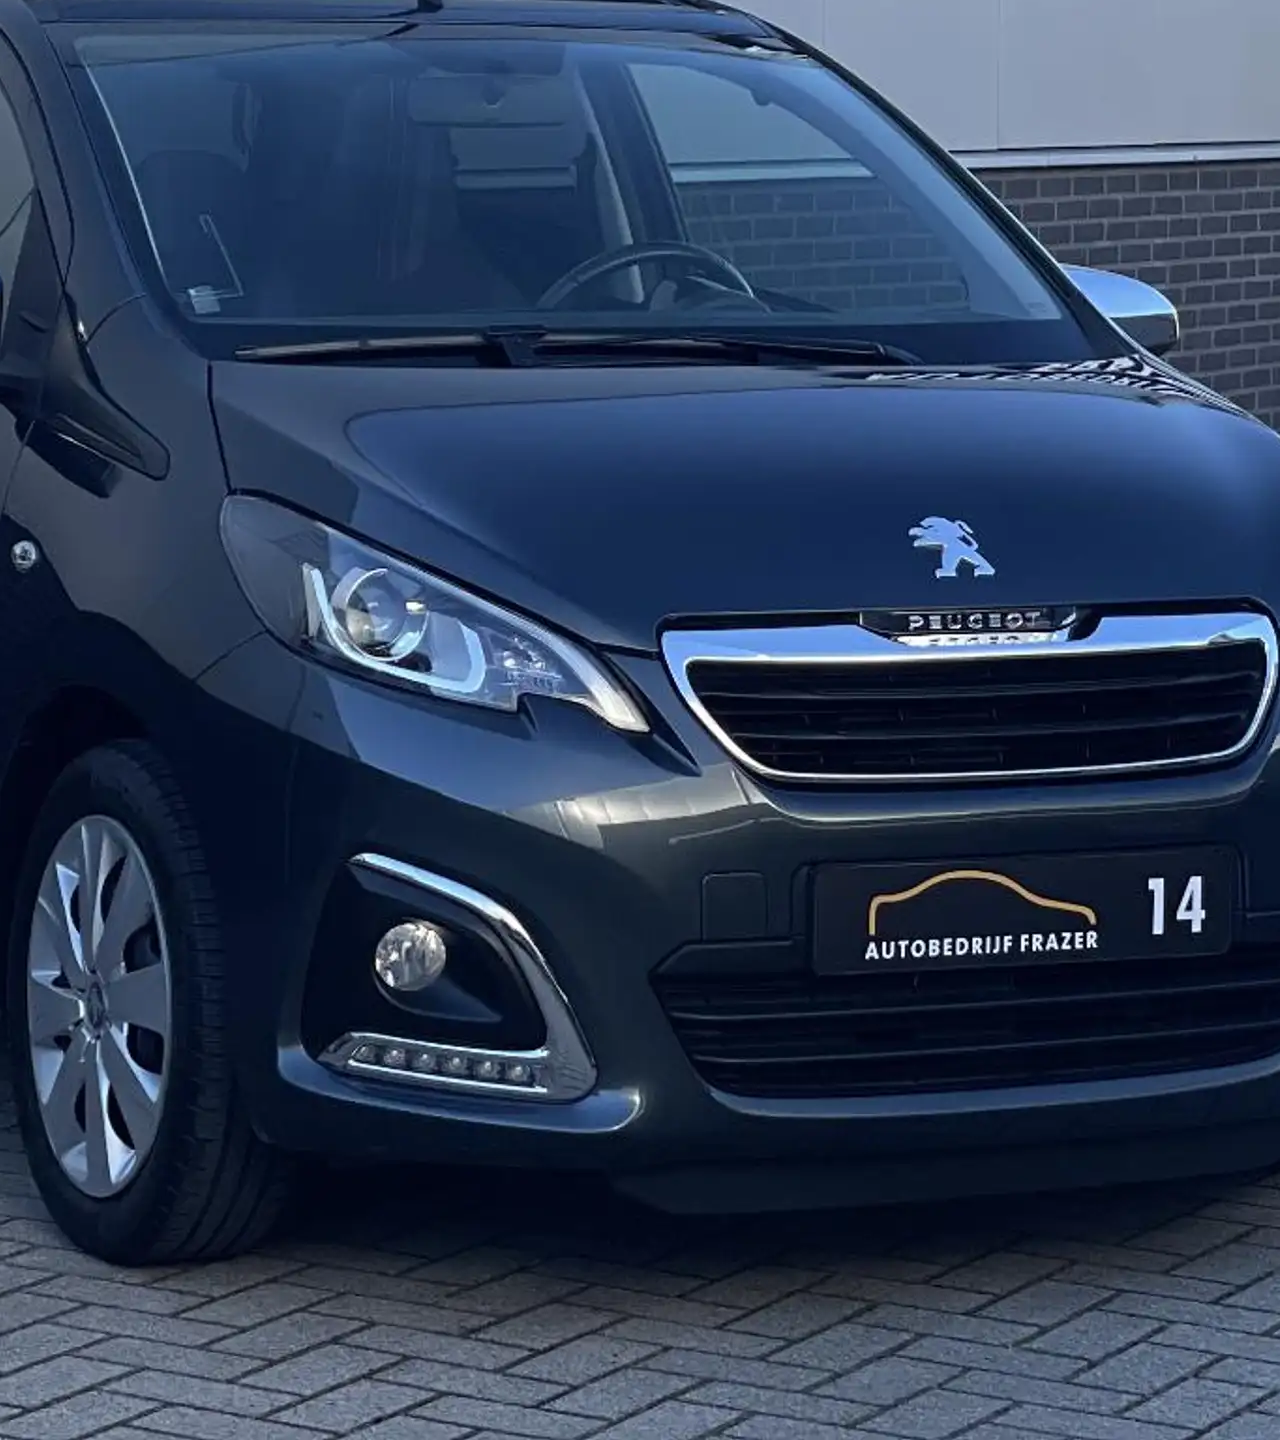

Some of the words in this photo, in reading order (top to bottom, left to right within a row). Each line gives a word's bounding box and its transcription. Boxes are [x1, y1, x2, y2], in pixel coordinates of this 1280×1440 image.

[907, 610, 1041, 632] PEUGEOT
[1147, 875, 1206, 936] 14
[864, 935, 1014, 961] AUTOBEDRIJF
[1019, 930, 1099, 954] FRAZER
